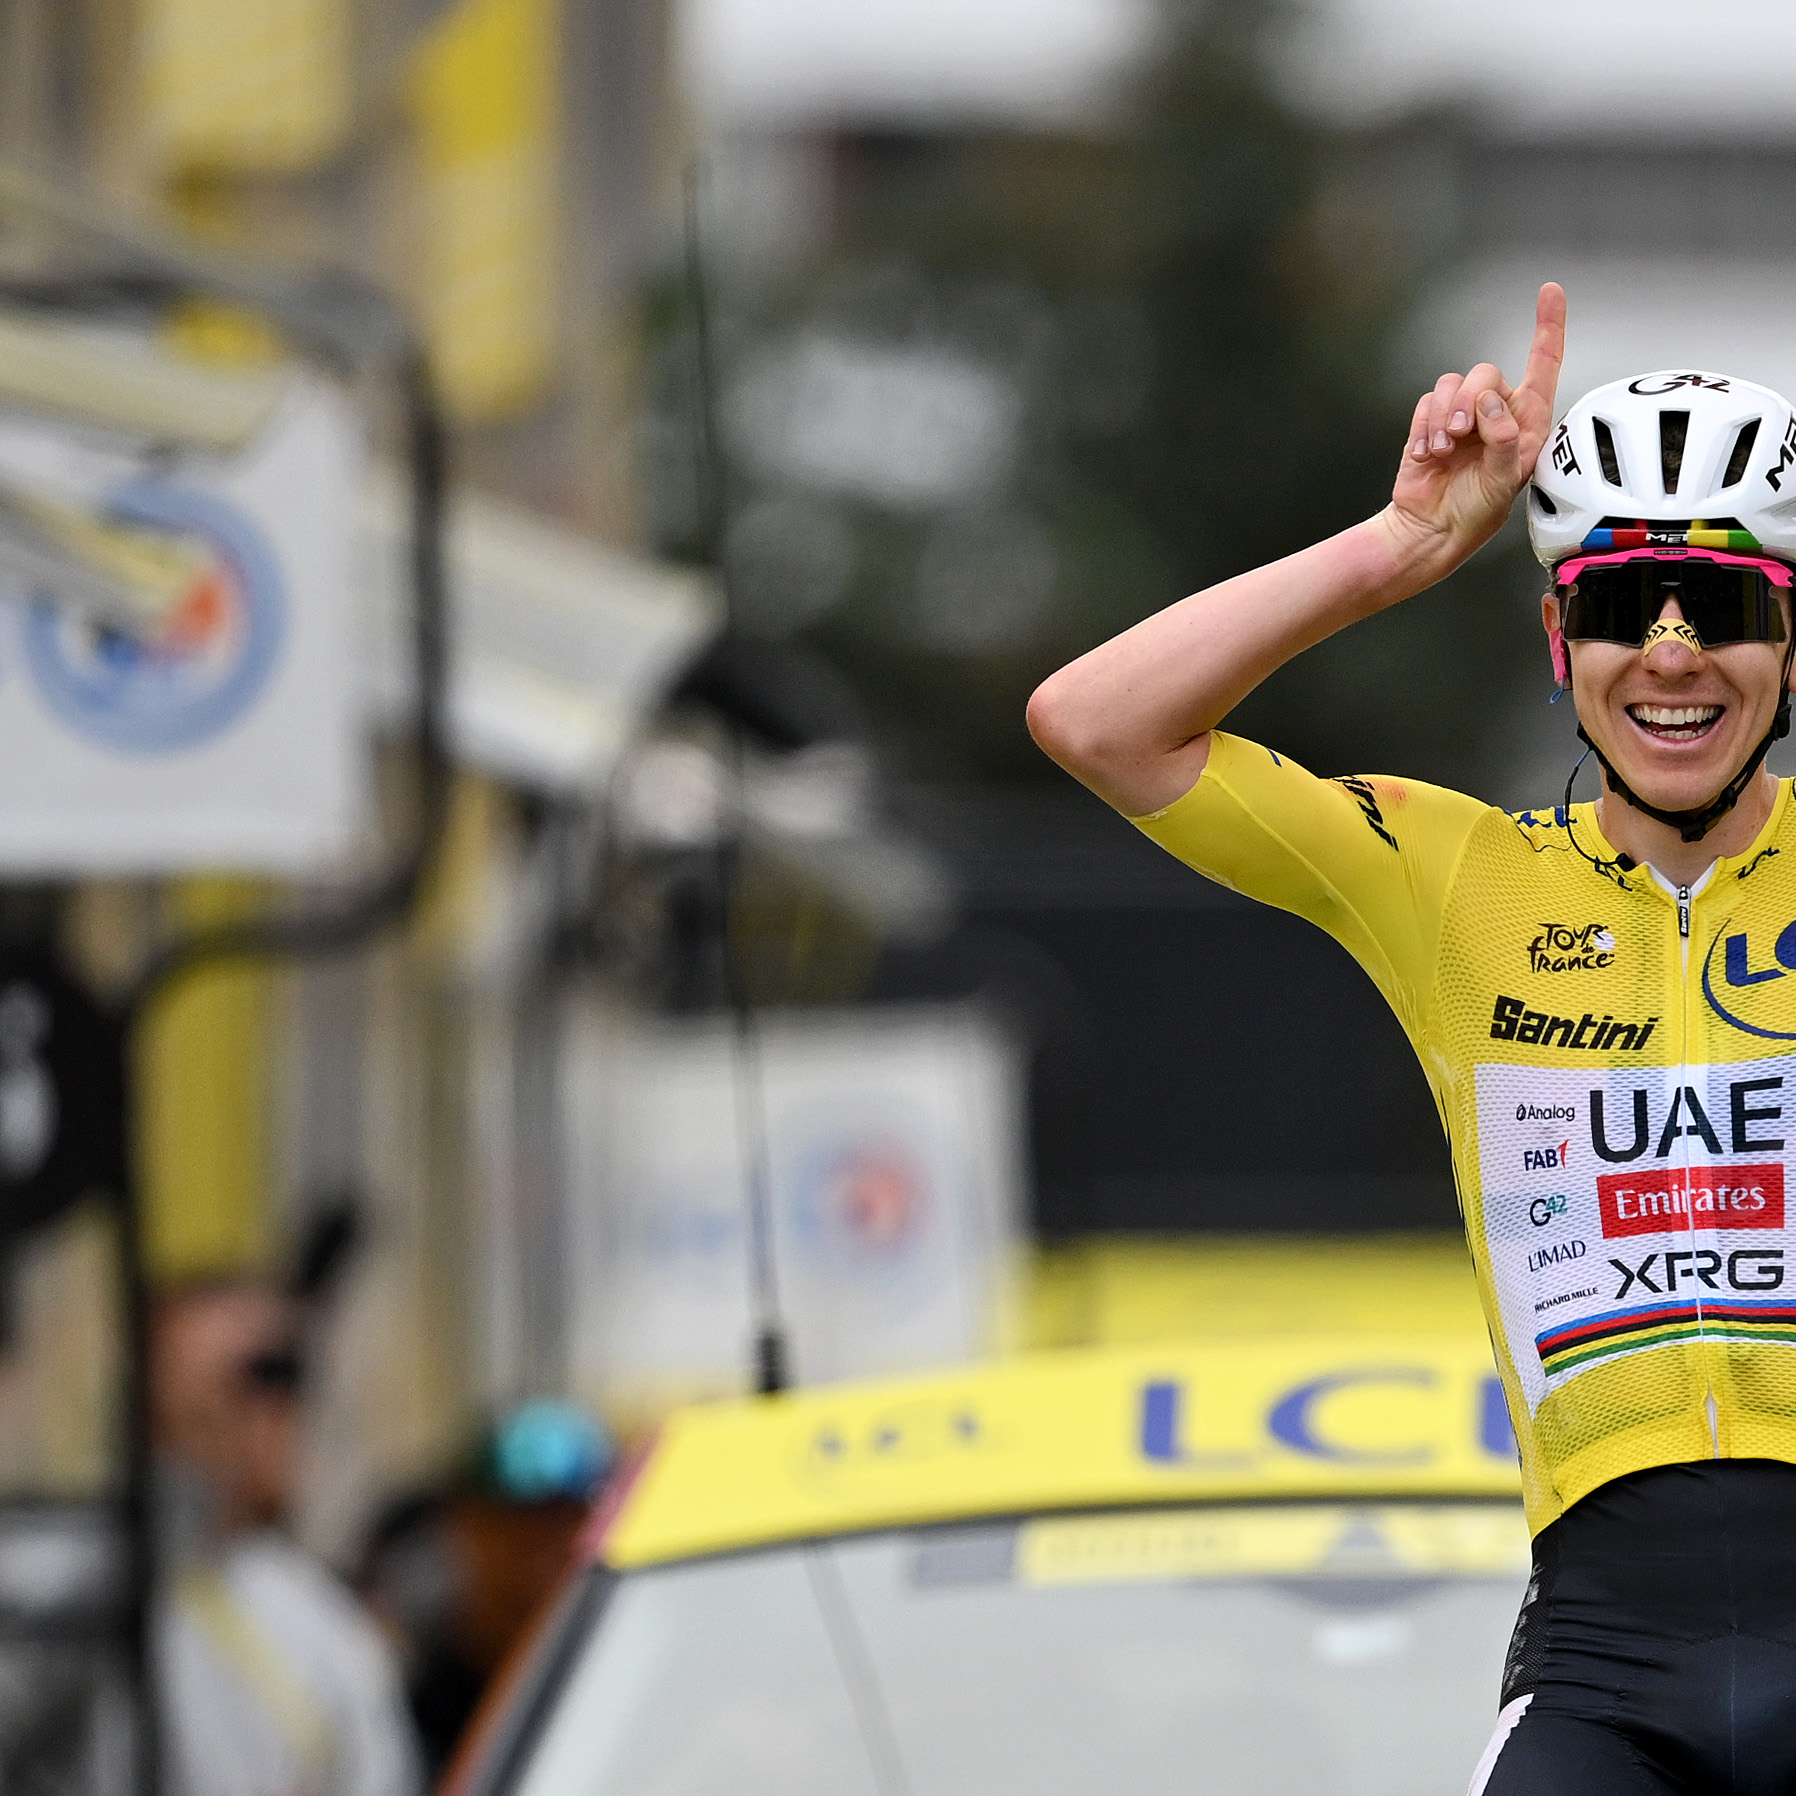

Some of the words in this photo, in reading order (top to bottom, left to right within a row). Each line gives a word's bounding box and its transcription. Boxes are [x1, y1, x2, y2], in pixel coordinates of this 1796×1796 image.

[1645, 532, 1693, 544] MET
[1489, 994, 1660, 1050] Santini
[1527, 1104, 1576, 1122] Analog
[1588, 1076, 1786, 1163] UAE
[1529, 1194, 1569, 1227] G42
[1615, 1181, 1767, 1221] Emirates
[1528, 1239, 1588, 1273] L'IMAD
[1607, 1249, 1786, 1301] XRG
[1534, 1292, 1570, 1313] RICHARD
[1571, 1286, 1599, 1301] MILLE
